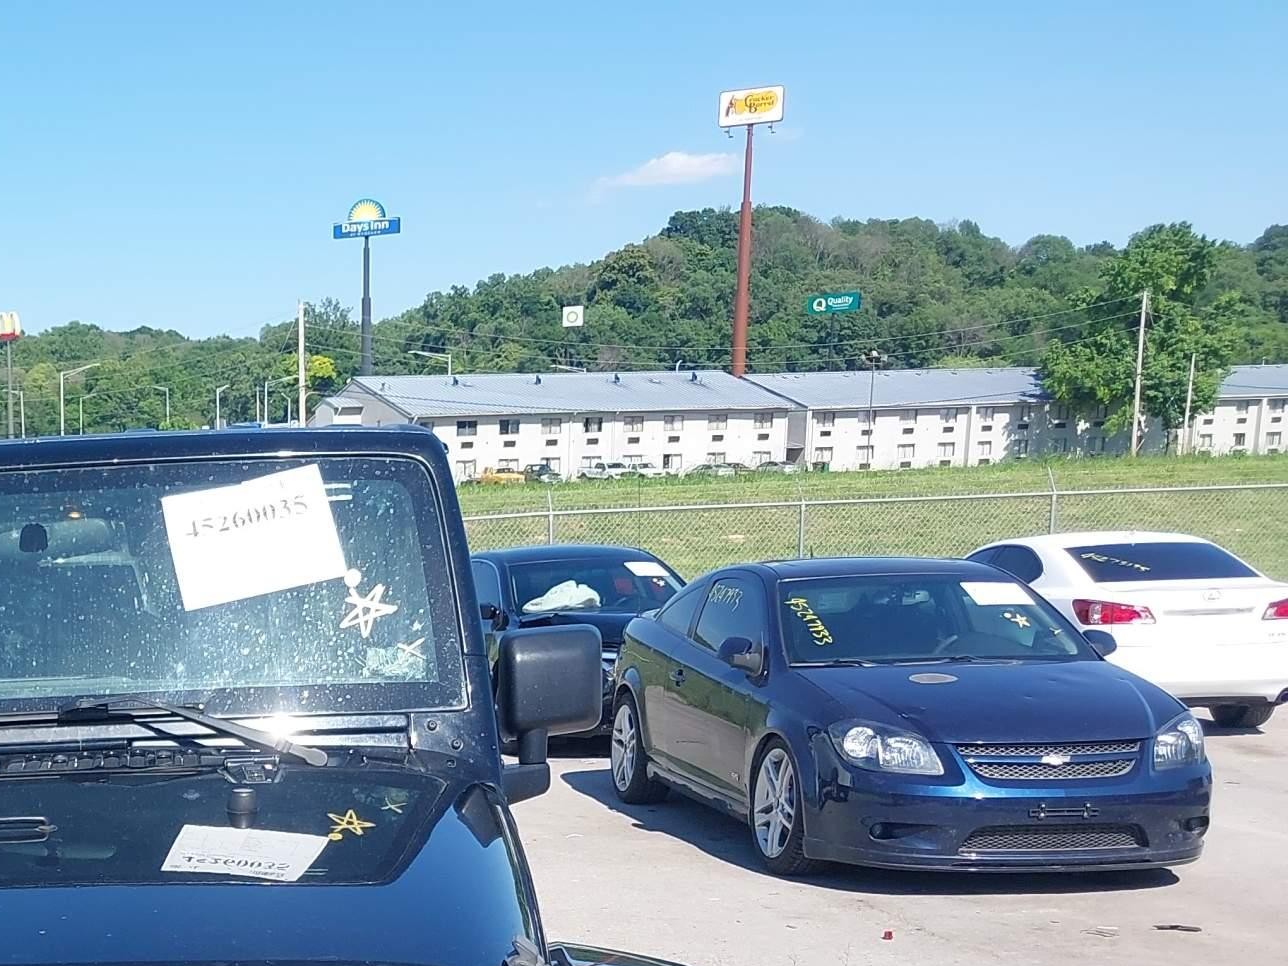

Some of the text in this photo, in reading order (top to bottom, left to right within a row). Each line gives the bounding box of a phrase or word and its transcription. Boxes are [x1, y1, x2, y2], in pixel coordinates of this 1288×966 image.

[342, 220, 390, 233] Days Inn
[827, 296, 854, 306] Quality
